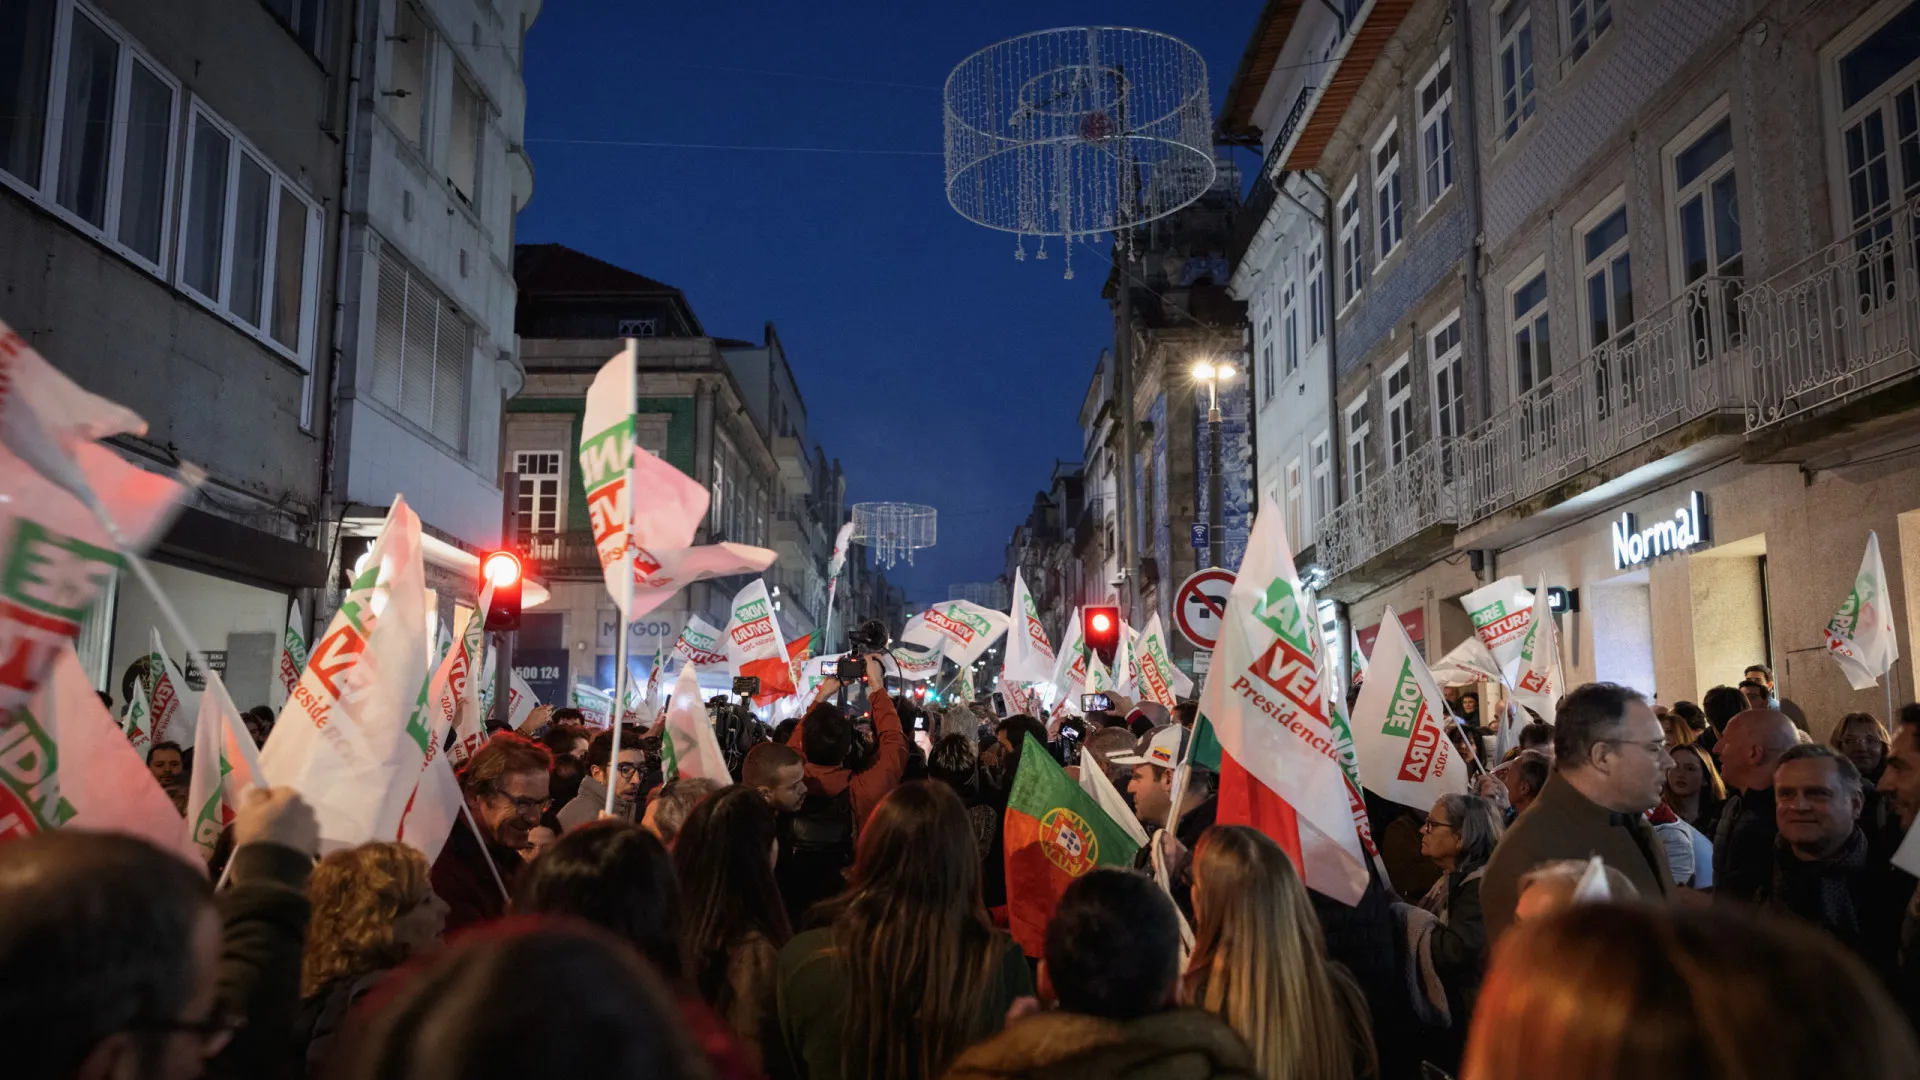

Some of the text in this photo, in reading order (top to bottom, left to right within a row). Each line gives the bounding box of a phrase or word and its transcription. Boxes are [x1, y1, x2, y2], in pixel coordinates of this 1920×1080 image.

[1612, 490, 1700, 571] Normal
[604, 622, 671, 637] MGOD
[516, 667, 559, 679] 500 124
